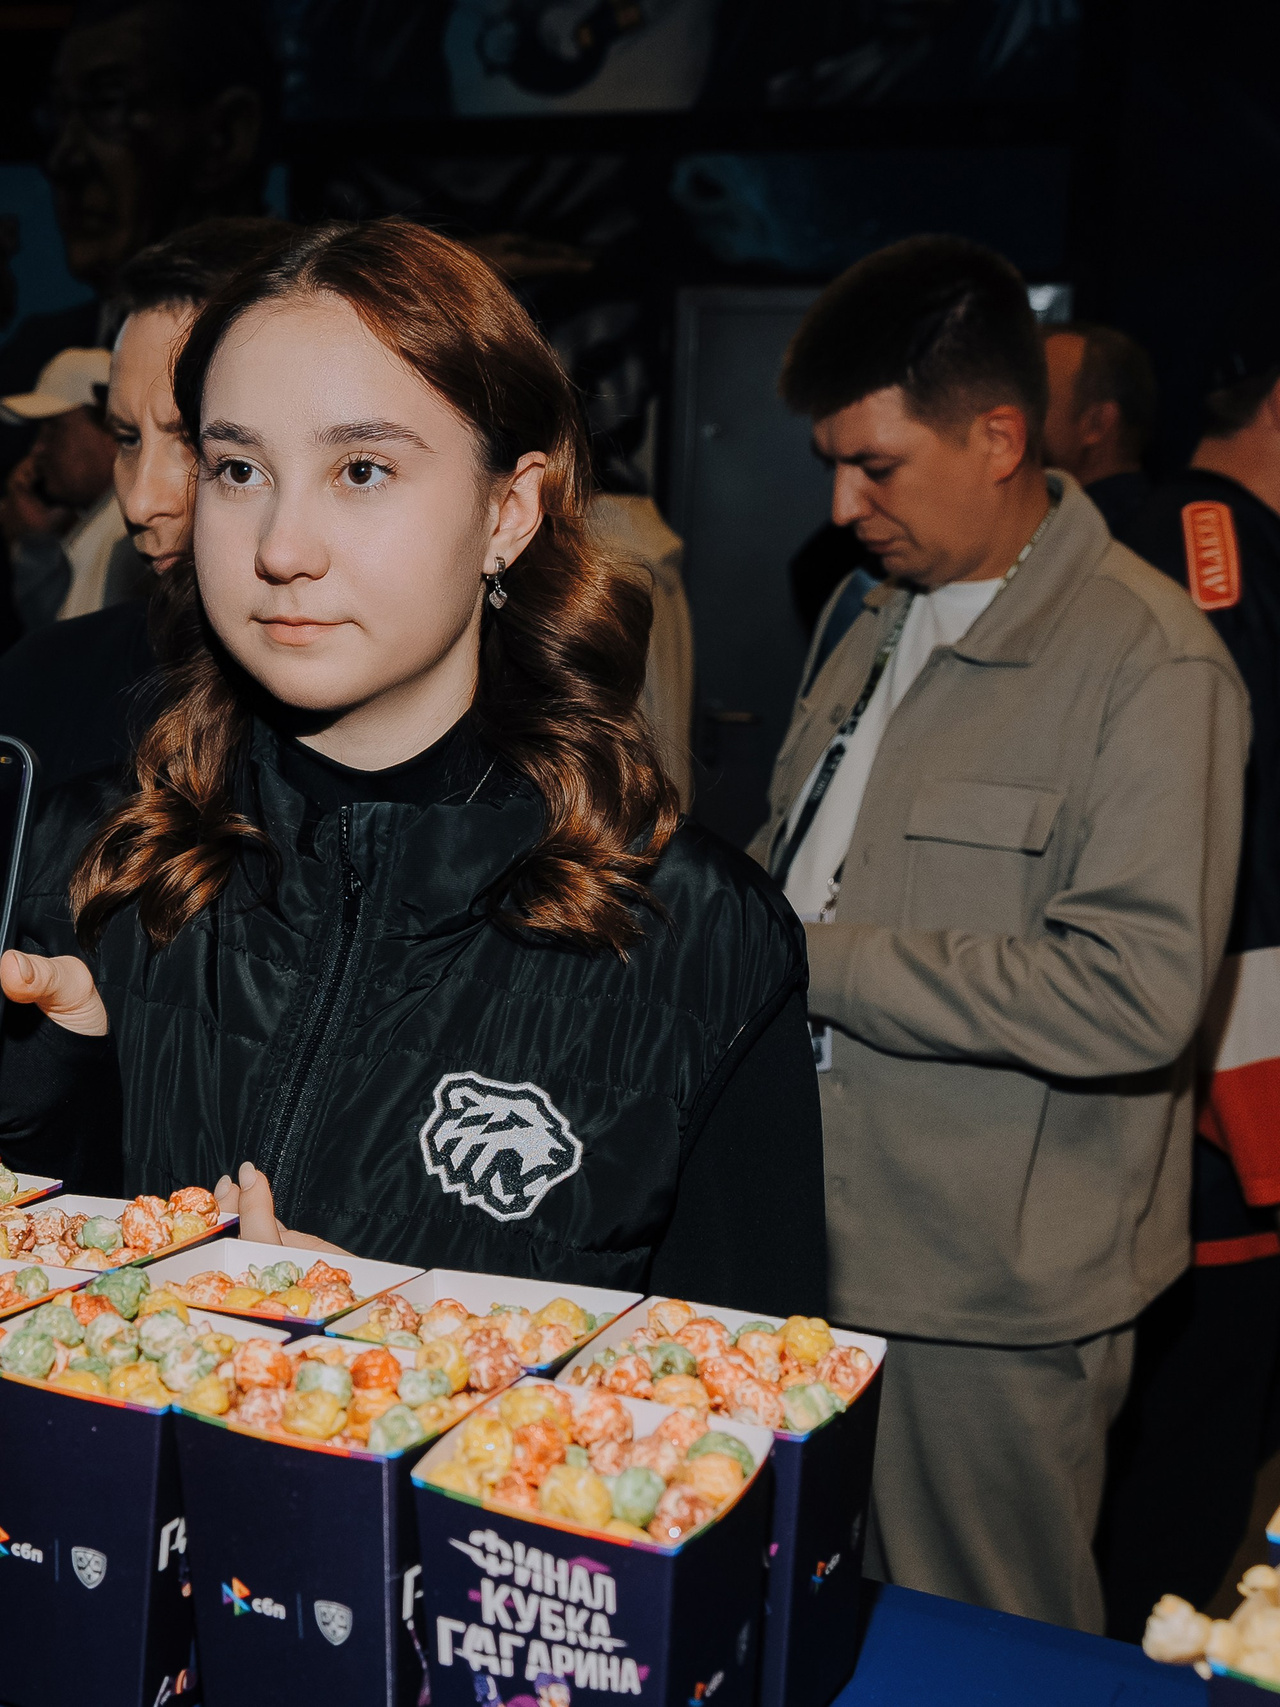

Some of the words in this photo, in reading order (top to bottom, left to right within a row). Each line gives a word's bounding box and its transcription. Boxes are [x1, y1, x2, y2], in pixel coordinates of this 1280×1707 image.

[10, 1542, 44, 1564] сбп
[450, 1529, 617, 1616] ФИНАЛ
[479, 1577, 627, 1652] КУБКА
[435, 1616, 642, 1696] ГАГАРИНА
